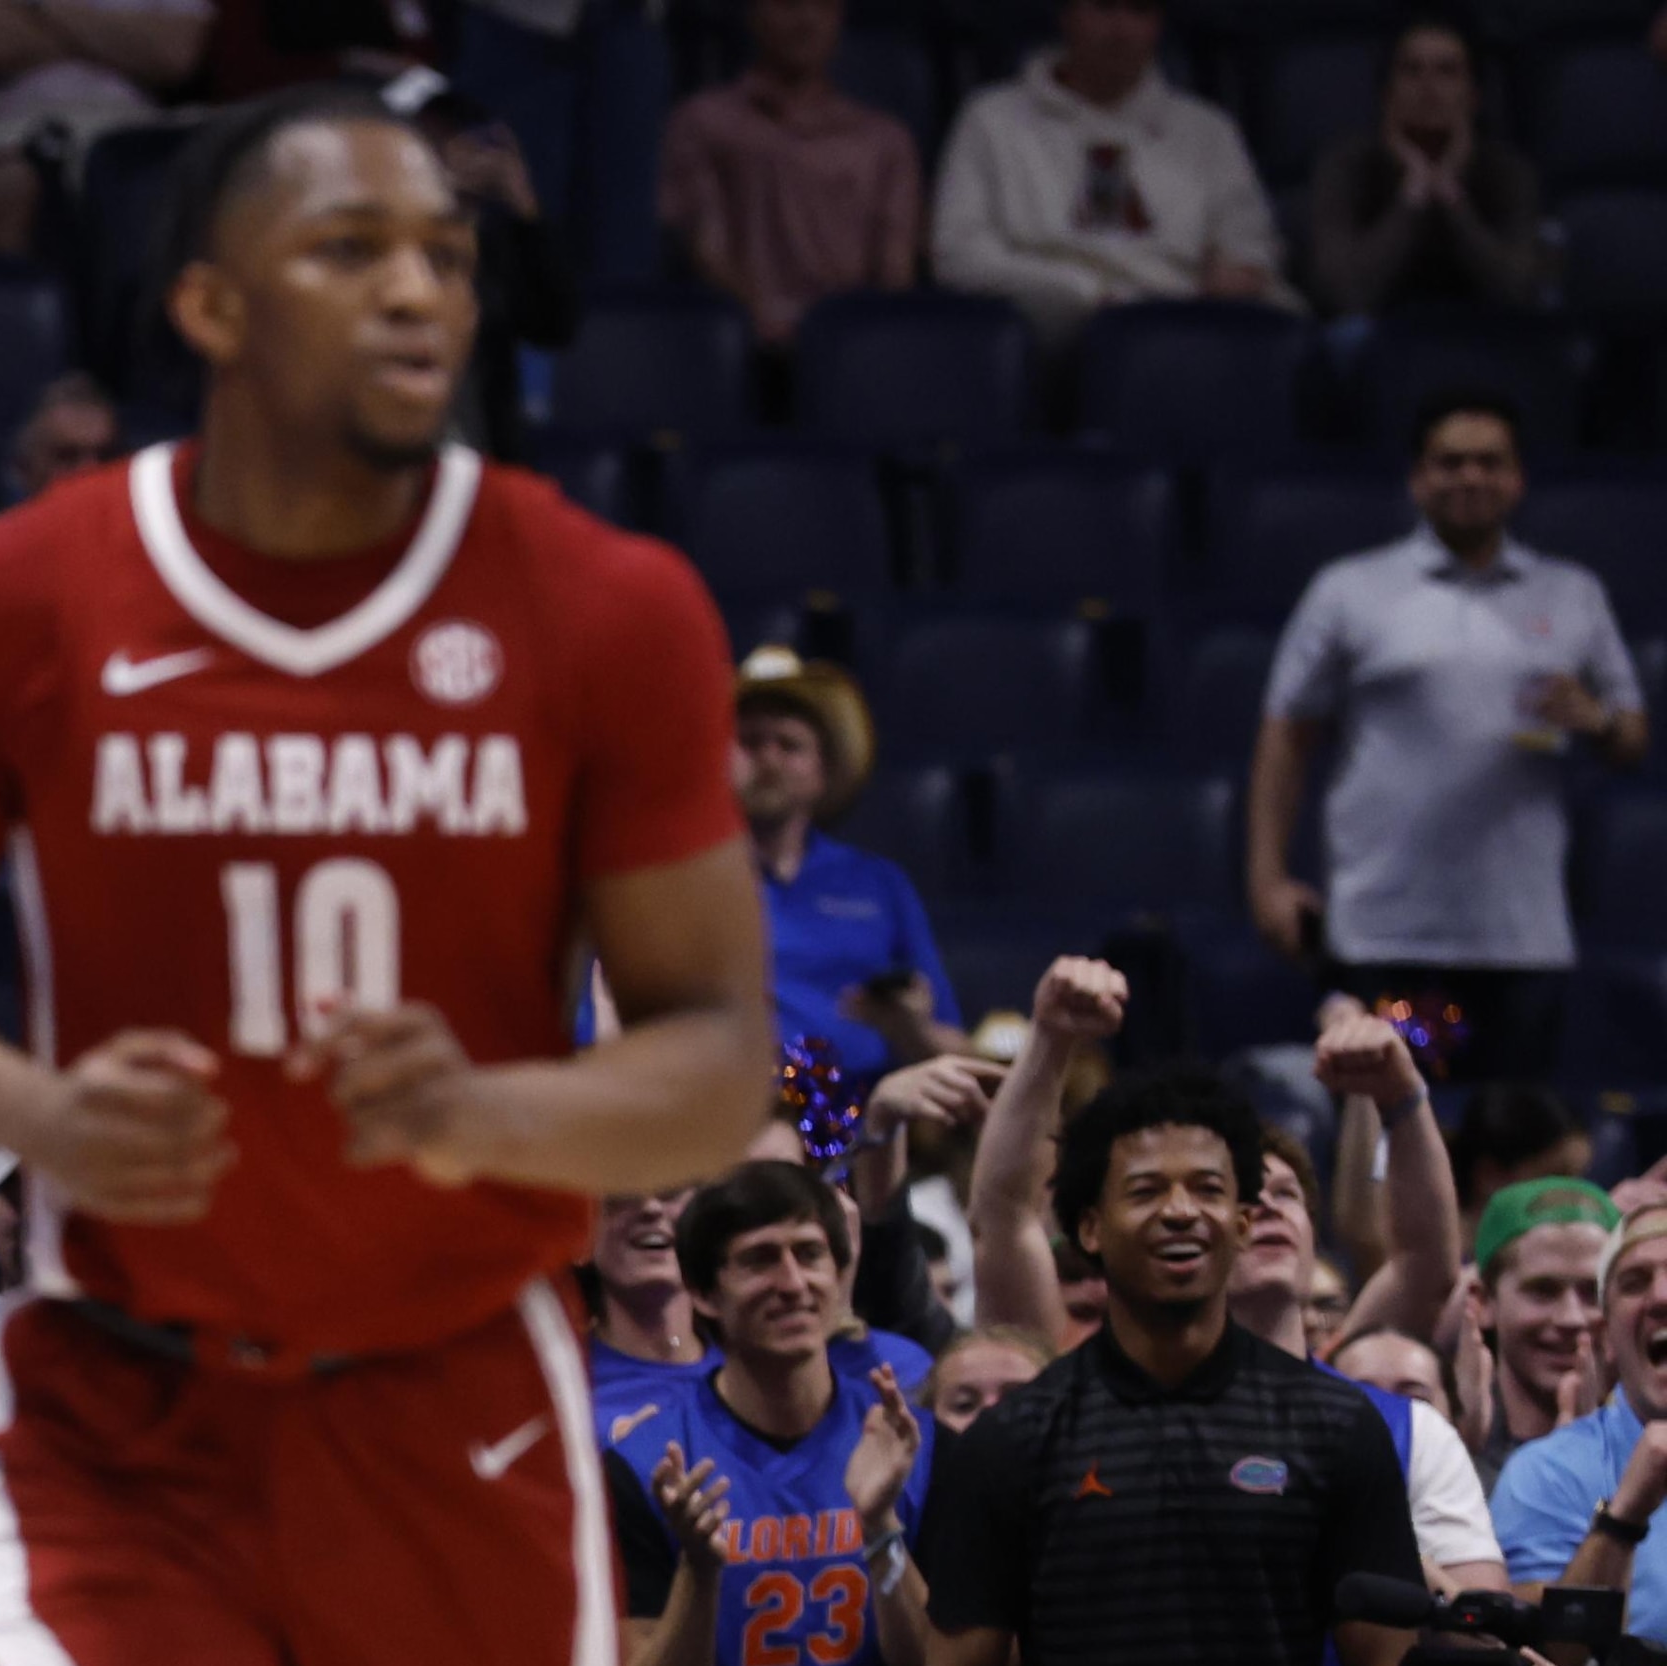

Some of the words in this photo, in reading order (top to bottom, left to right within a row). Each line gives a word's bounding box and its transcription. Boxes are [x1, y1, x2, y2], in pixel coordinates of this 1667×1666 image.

[90, 732, 528, 836] ALABAMA
[219, 857, 401, 1056] 10
[724, 1509, 863, 1565] LORID
